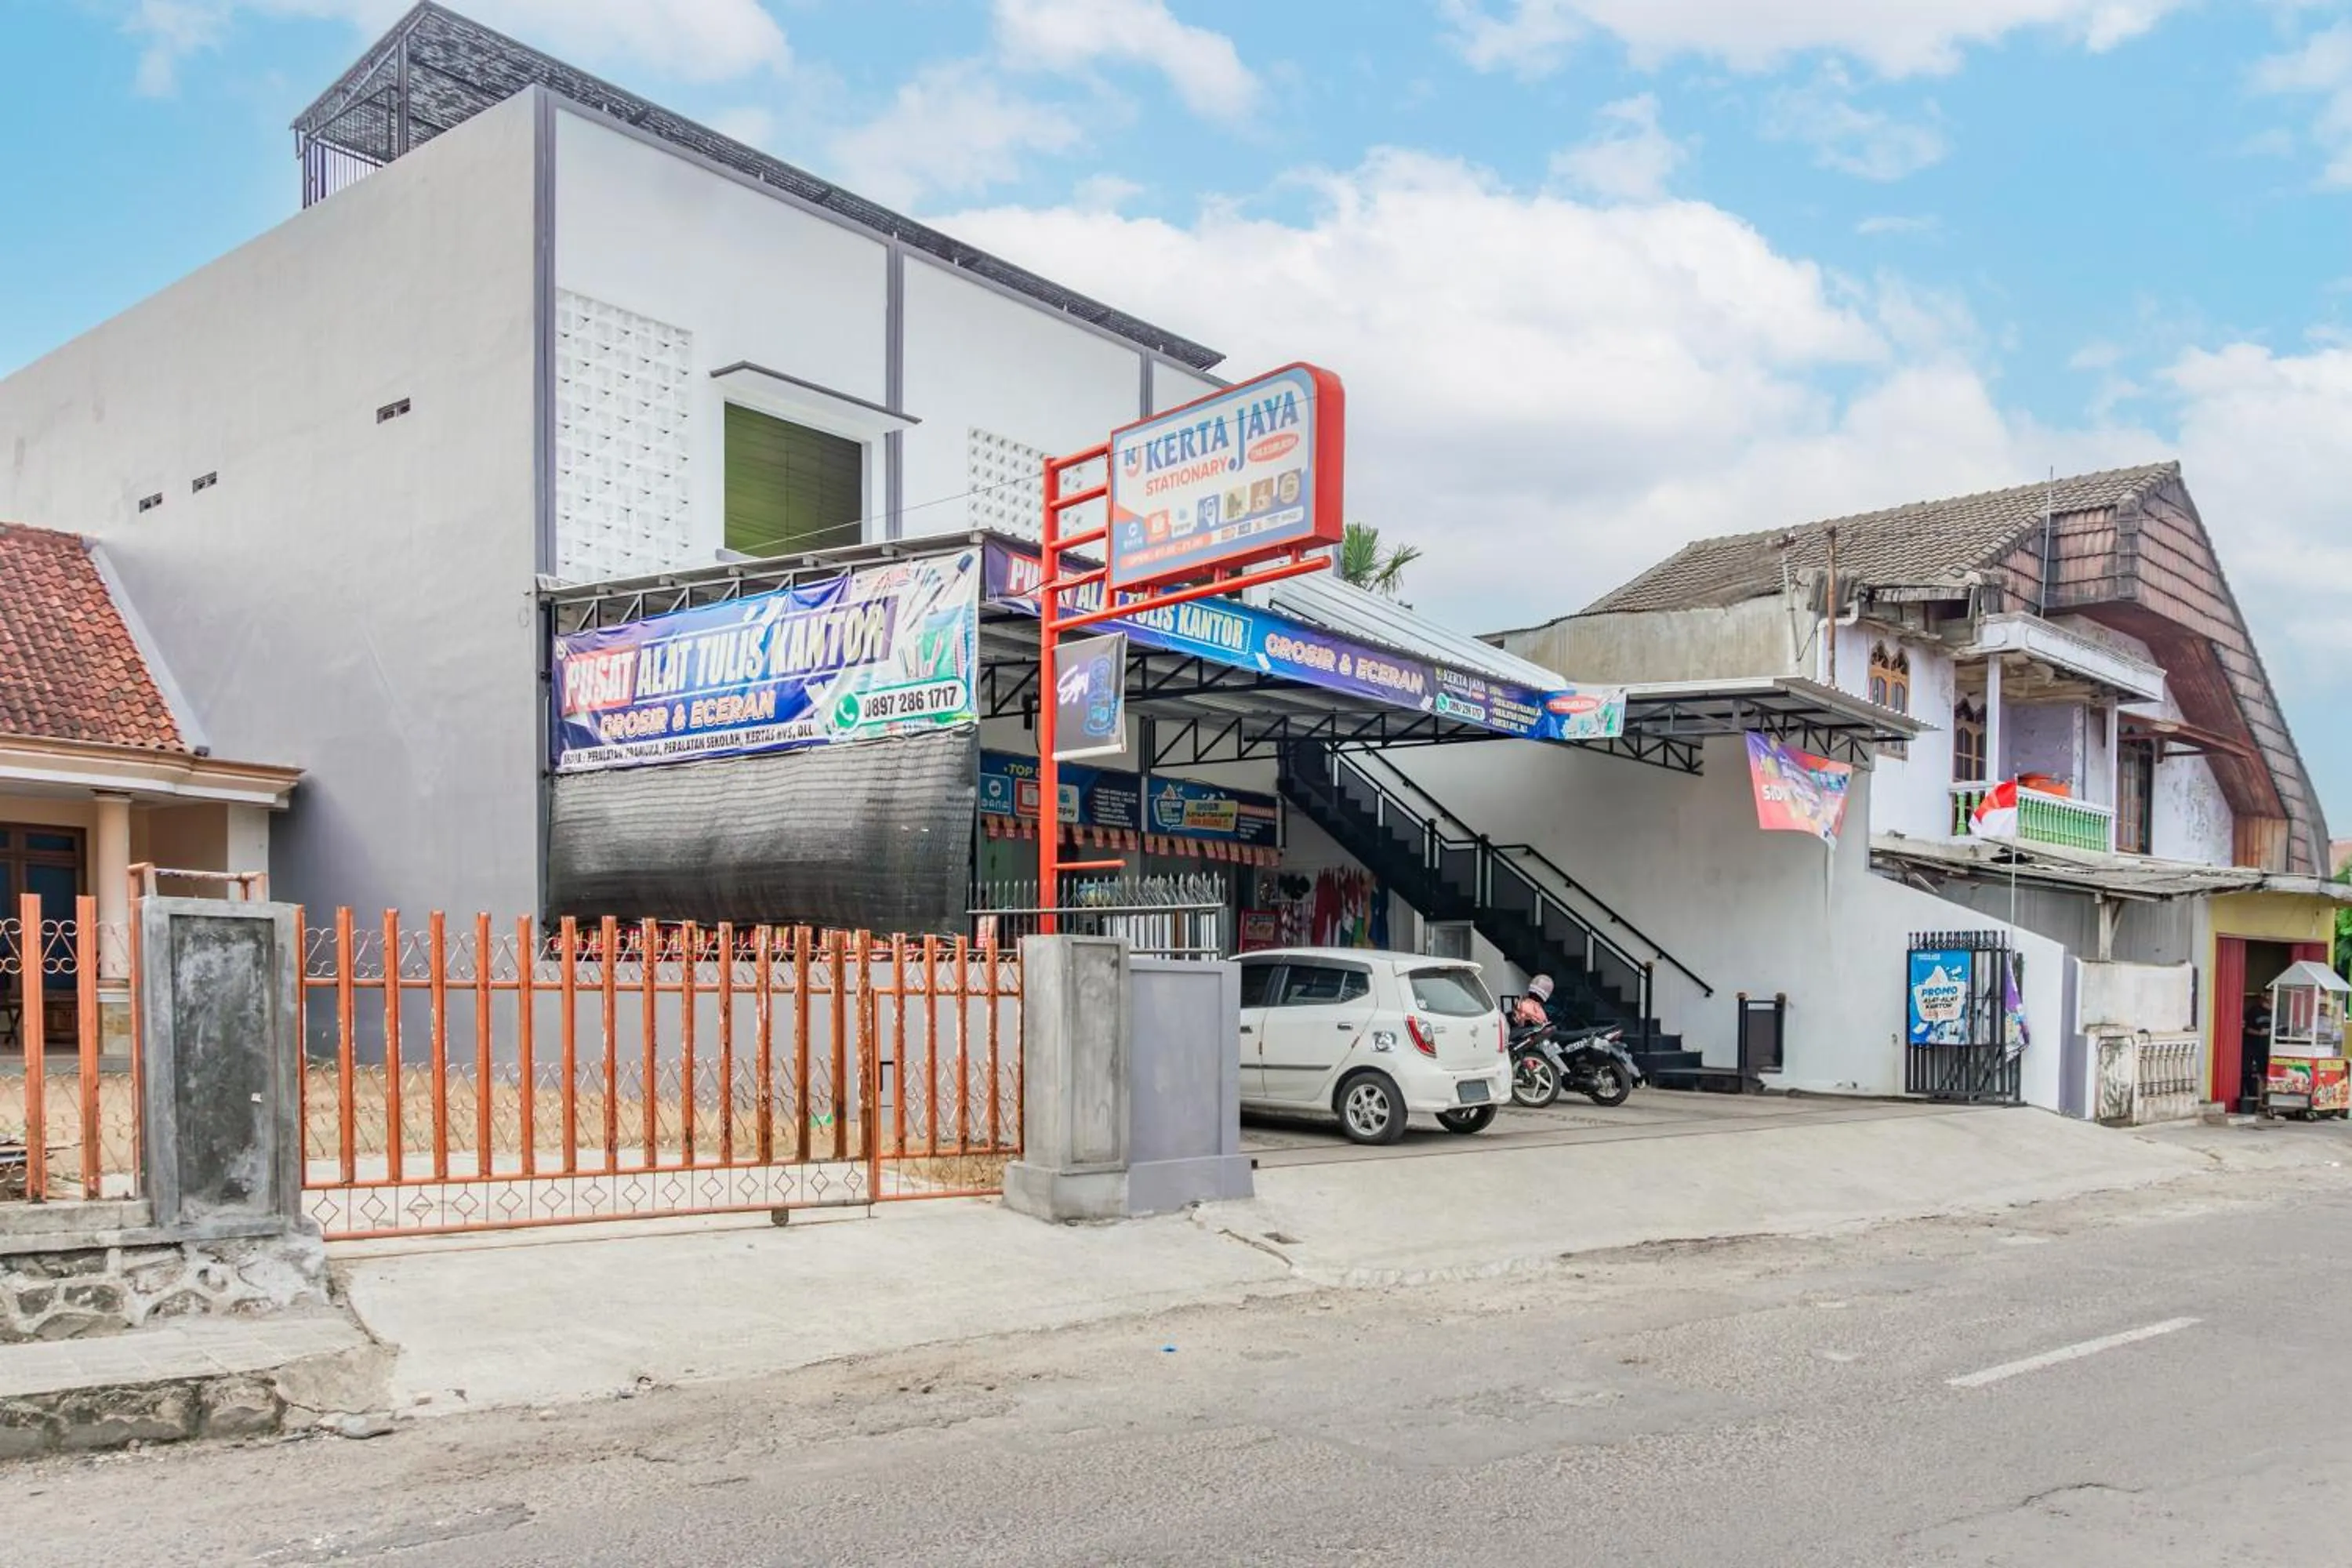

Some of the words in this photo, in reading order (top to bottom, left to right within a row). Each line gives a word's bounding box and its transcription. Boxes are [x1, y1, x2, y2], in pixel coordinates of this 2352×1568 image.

[1145, 415, 1229, 474] KERTA
[1229, 390, 1300, 472] JAYA
[1145, 456, 1229, 496] STATIONARY
[1178, 604, 1244, 649] KANTOR
[564, 650, 636, 709] PUSAT
[636, 642, 691, 697] ALAT
[695, 625, 766, 687] TULIS
[769, 601, 886, 674] KANTOR
[1338, 652, 1352, 676] &
[1356, 657, 1424, 695] ECERAN
[601, 707, 668, 739] GROSIR
[672, 702, 687, 731] &
[690, 689, 777, 728] ECERAN
[864, 691, 895, 718] 0897
[898, 689, 924, 713] 286
[927, 686, 958, 710] 1717
[664, 738, 705, 753] PERALATAN
[706, 732, 744, 750] SEKOLAH,
[746, 728, 776, 744] KERTAS
[798, 723, 813, 737] DLL
[1008, 763, 1033, 777] TOP
[1922, 985, 1958, 996] PROMO
